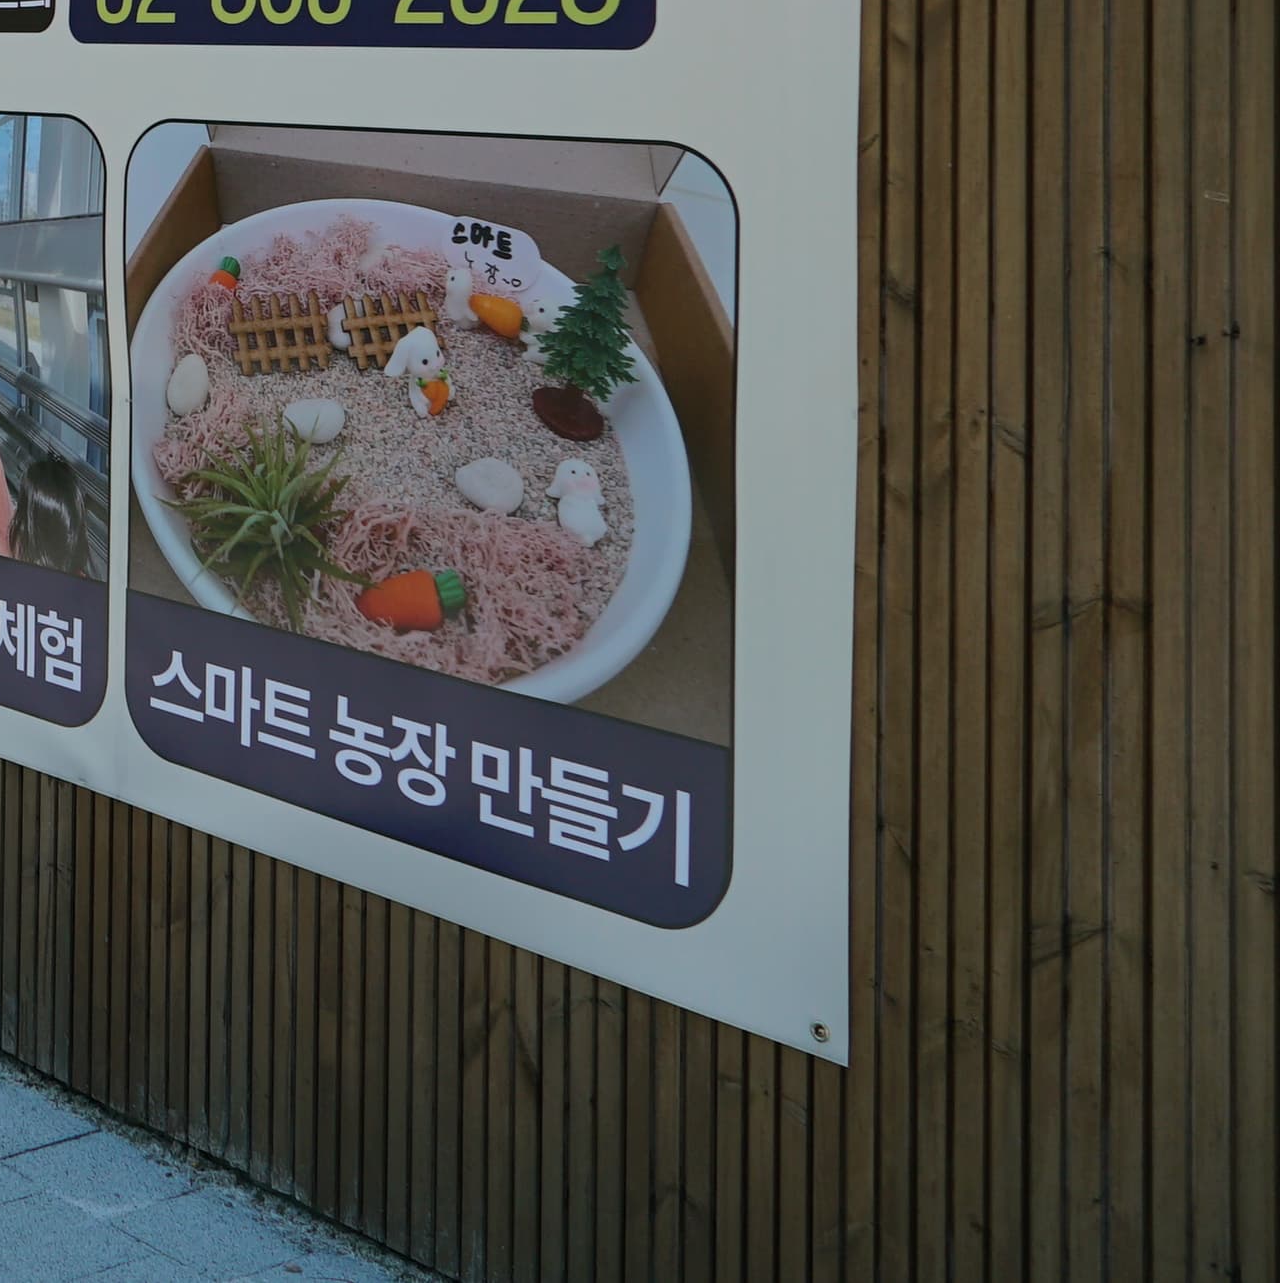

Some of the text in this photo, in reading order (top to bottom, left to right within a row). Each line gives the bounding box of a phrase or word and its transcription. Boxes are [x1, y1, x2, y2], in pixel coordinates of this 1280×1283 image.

[451, 222, 513, 260] 스마트
[149, 650, 691, 888] 스마트 농장 만들기
